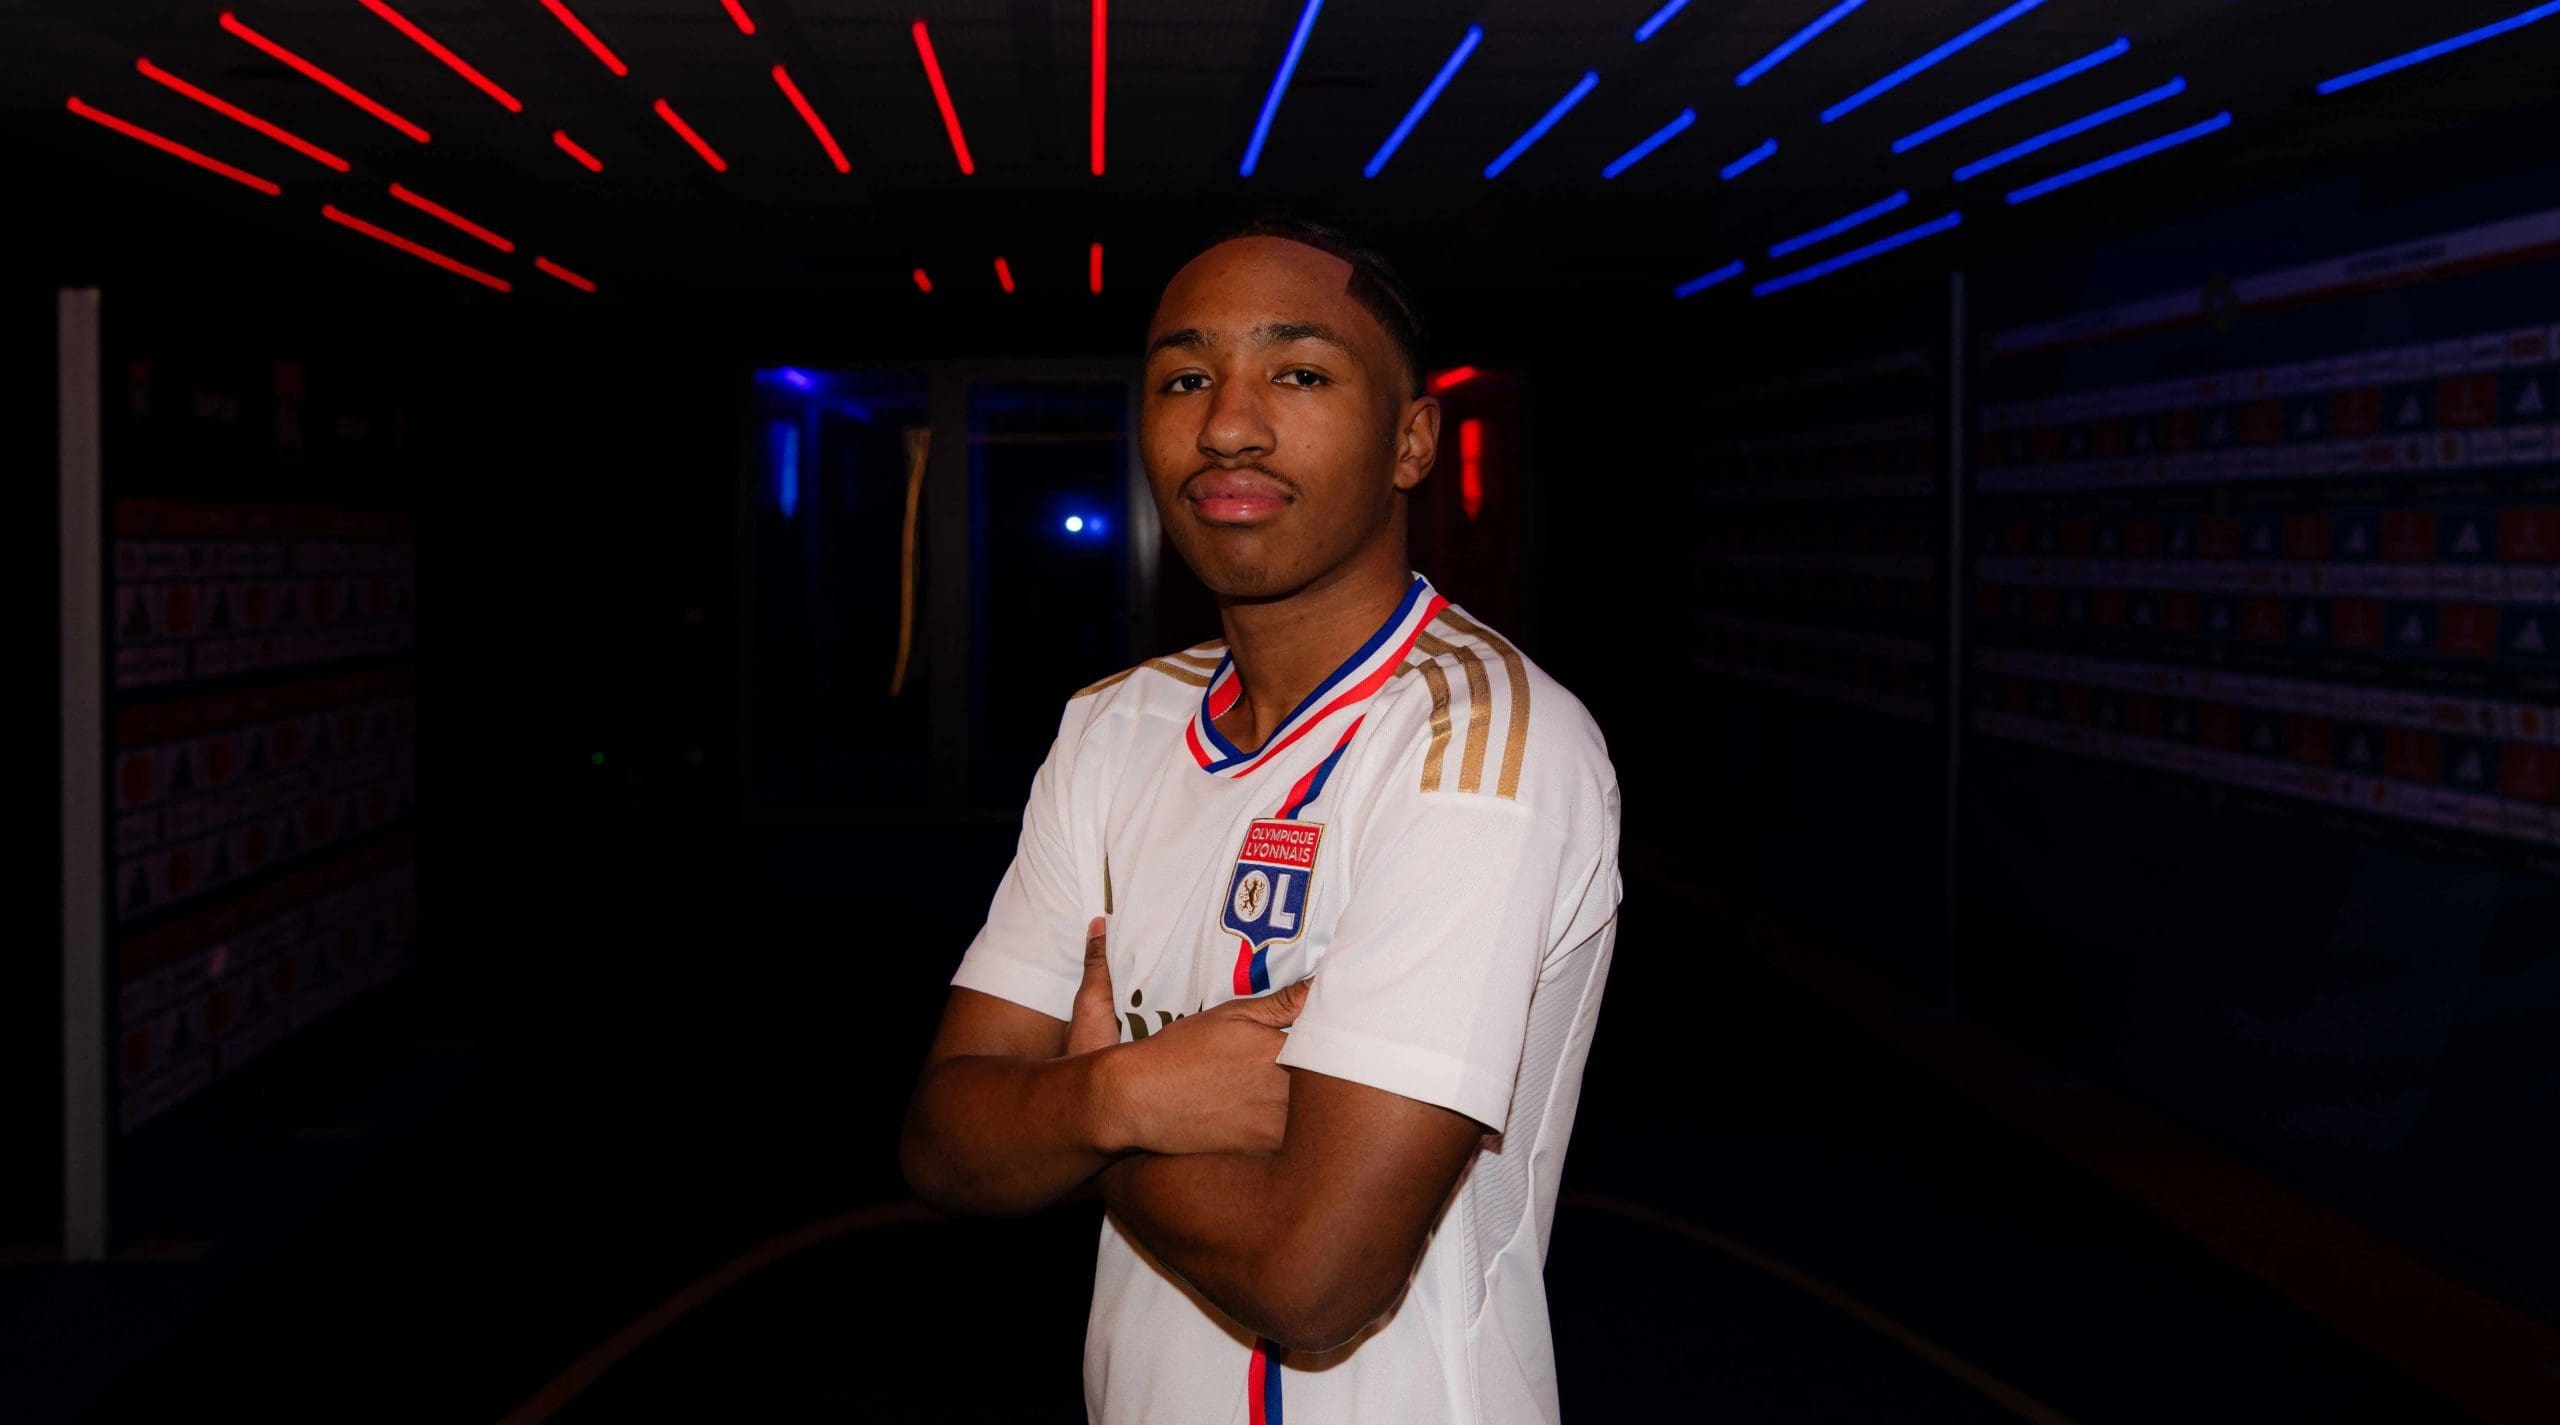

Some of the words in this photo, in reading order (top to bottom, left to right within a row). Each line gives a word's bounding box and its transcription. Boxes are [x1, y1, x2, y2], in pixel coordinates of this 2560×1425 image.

[1251, 828, 1316, 845] OLYMPIQUE
[1245, 843, 1311, 863] LYONNAIS
[1234, 870, 1295, 930] OL
